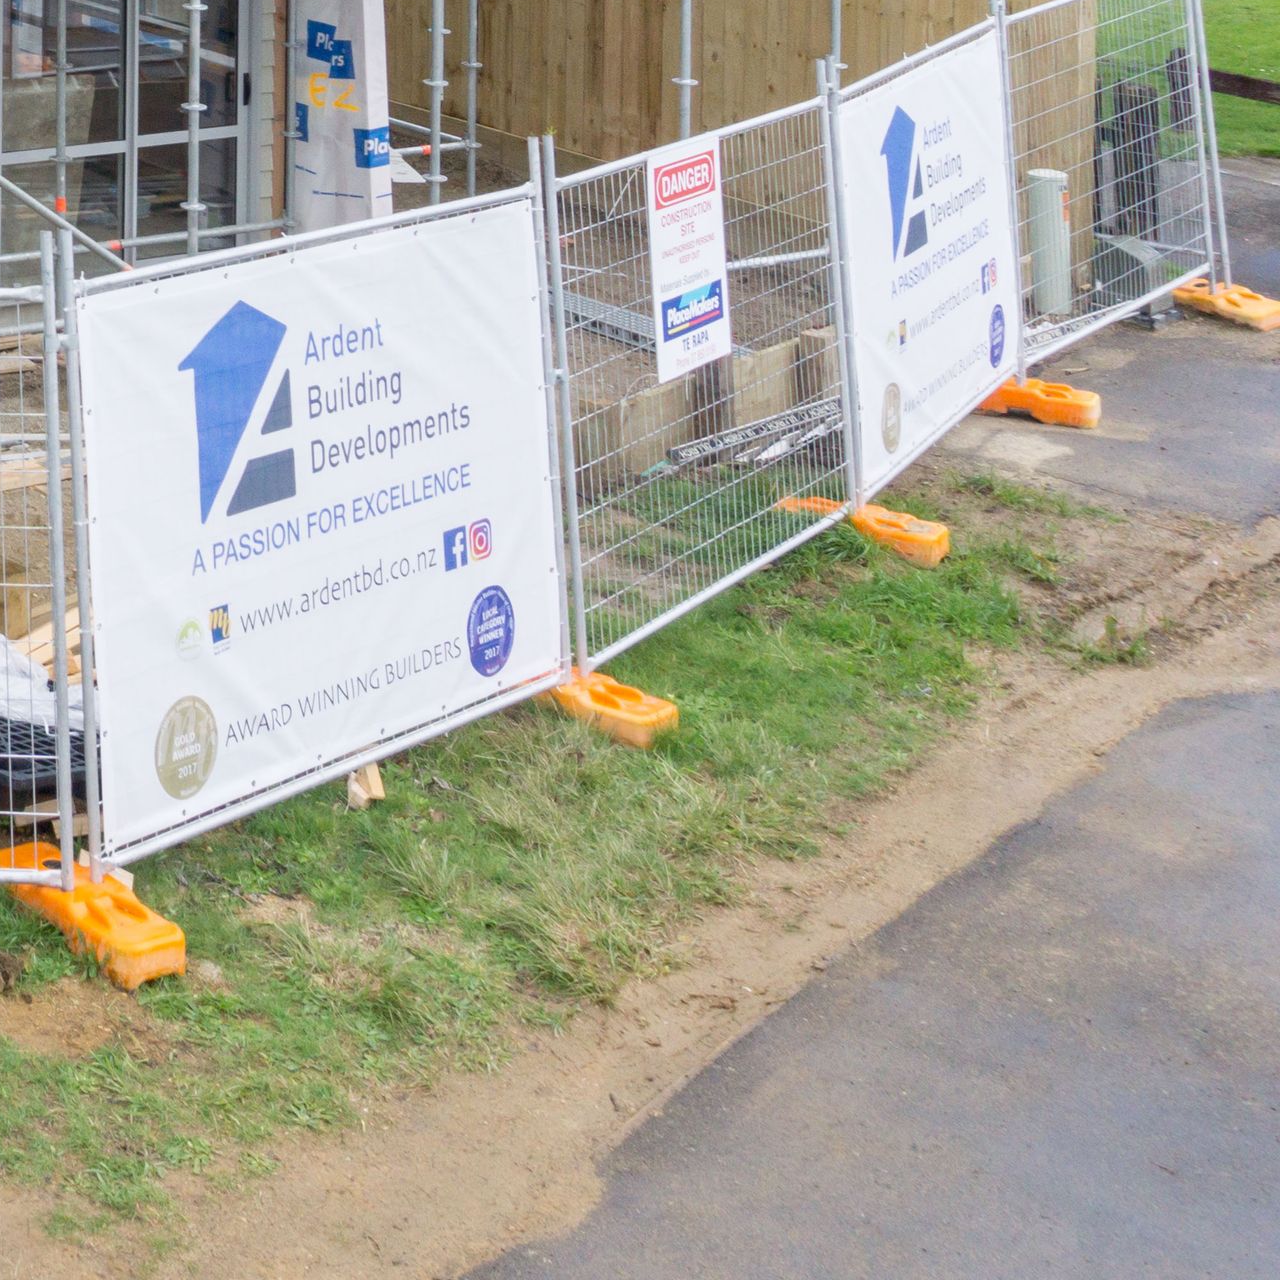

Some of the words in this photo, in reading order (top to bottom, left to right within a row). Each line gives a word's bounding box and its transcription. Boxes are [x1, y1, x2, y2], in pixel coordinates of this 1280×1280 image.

[661, 162, 710, 198] DANGER
[660, 200, 713, 228] CONSTRUCTION
[680, 221, 696, 237] SITE
[666, 293, 720, 329] PlaceMakers
[304, 317, 384, 365] Ardent
[682, 337, 691, 352] TE
[692, 329, 710, 349] RAPA
[307, 370, 402, 419] Building
[310, 402, 471, 474] Developments
[192, 549, 207, 576] A
[212, 517, 301, 570] PASSION
[307, 503, 347, 539] FOR
[352, 463, 472, 524] EXCELLENCE
[240, 547, 438, 633] www.ardentbd.co.nz
[484, 645, 500, 661] 2017
[225, 703, 293, 747] AWARD
[297, 668, 381, 719] WINNING
[385, 636, 463, 686] BUILDERS
[172, 743, 201, 762] AWARD
[173, 731, 196, 748] GOLD
[177, 762, 198, 779] 2017
